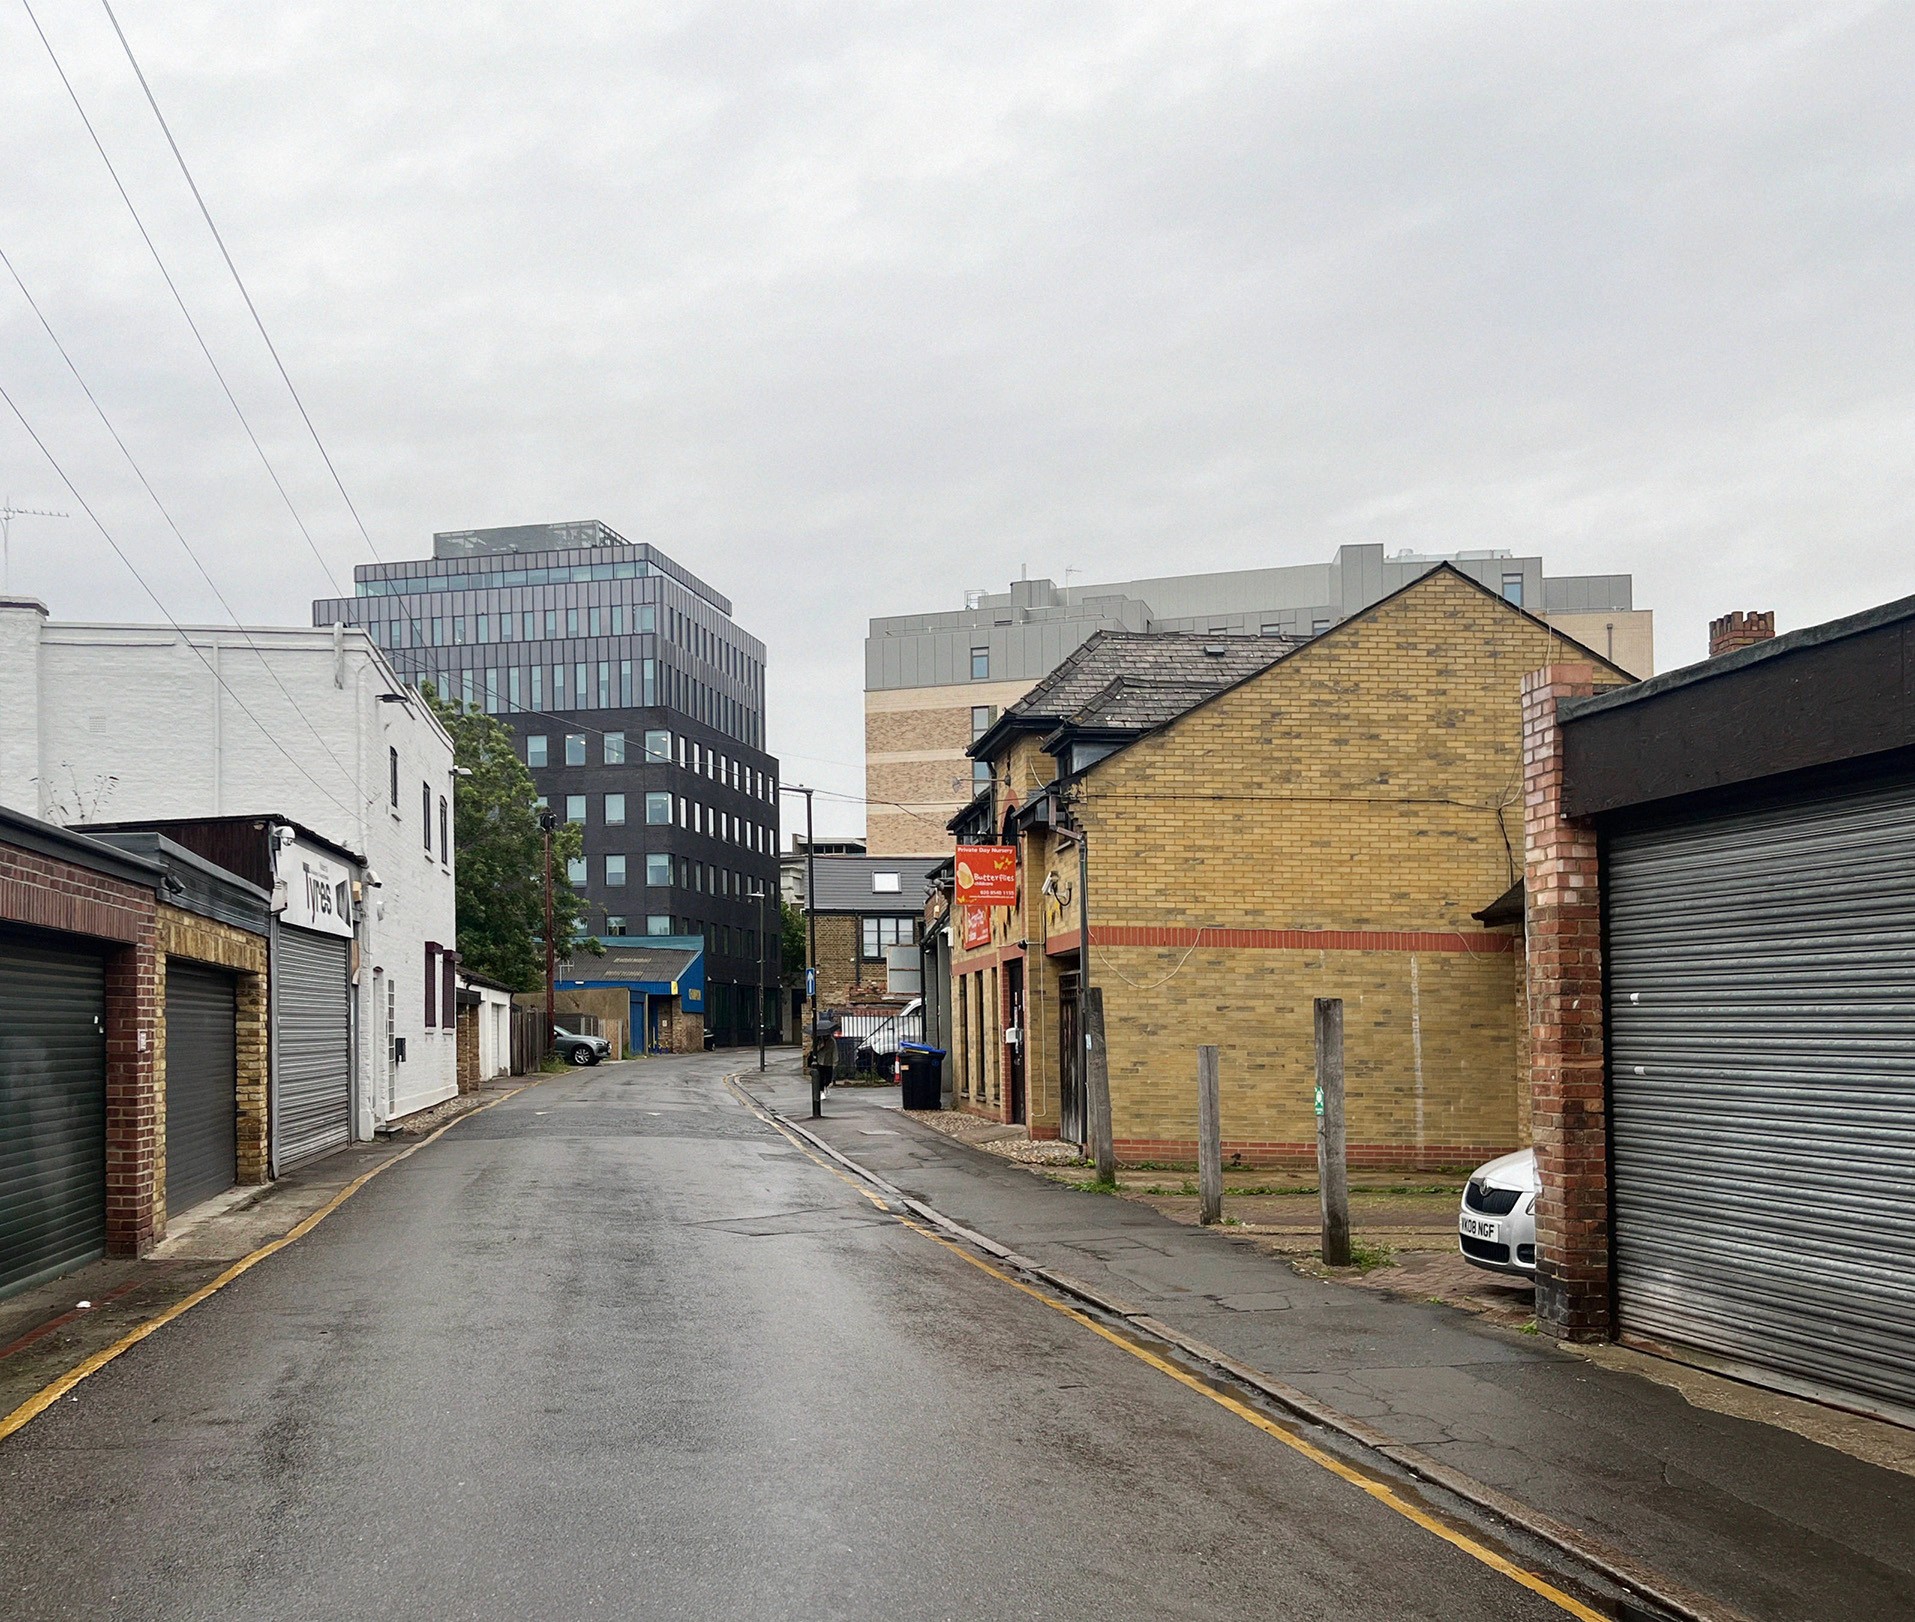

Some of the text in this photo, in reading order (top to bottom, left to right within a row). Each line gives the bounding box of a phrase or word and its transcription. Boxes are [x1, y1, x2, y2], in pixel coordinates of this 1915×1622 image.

[973, 873, 1014, 882] Butterflies
[302, 861, 332, 923] Tyres
[1478, 1222, 1494, 1238] NGF
